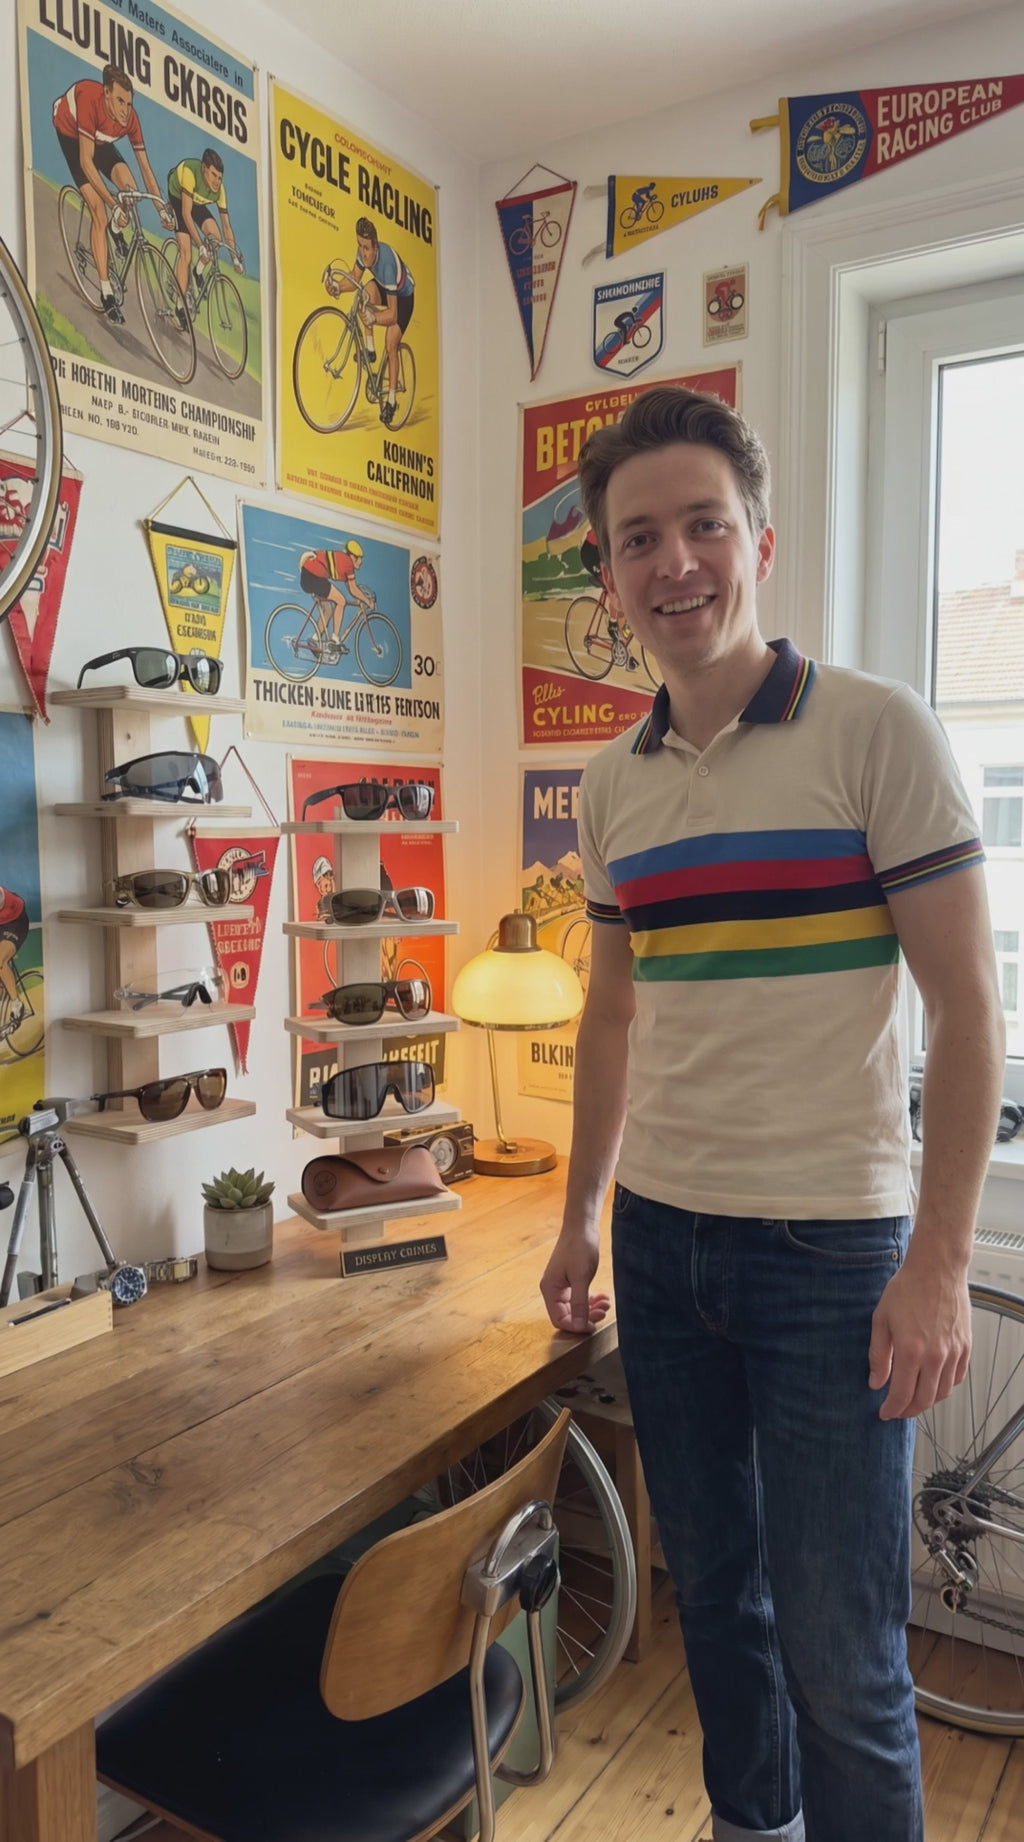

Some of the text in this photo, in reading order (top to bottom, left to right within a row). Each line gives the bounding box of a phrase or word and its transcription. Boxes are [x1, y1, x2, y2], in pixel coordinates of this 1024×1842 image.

[234, 71, 244, 88] in
[164, 54, 248, 144] CKRSIS
[877, 81, 1003, 128] EUROPEAN
[877, 112, 953, 165] RACING
[959, 98, 1002, 125] CLUB
[280, 118, 351, 194] CYCLE
[358, 164, 433, 247] RACLING
[671, 184, 719, 208] CYLUHS
[383, 439, 434, 477] KOHNN'S
[413, 654, 435, 677] 30
[533, 703, 615, 726] CYLING
